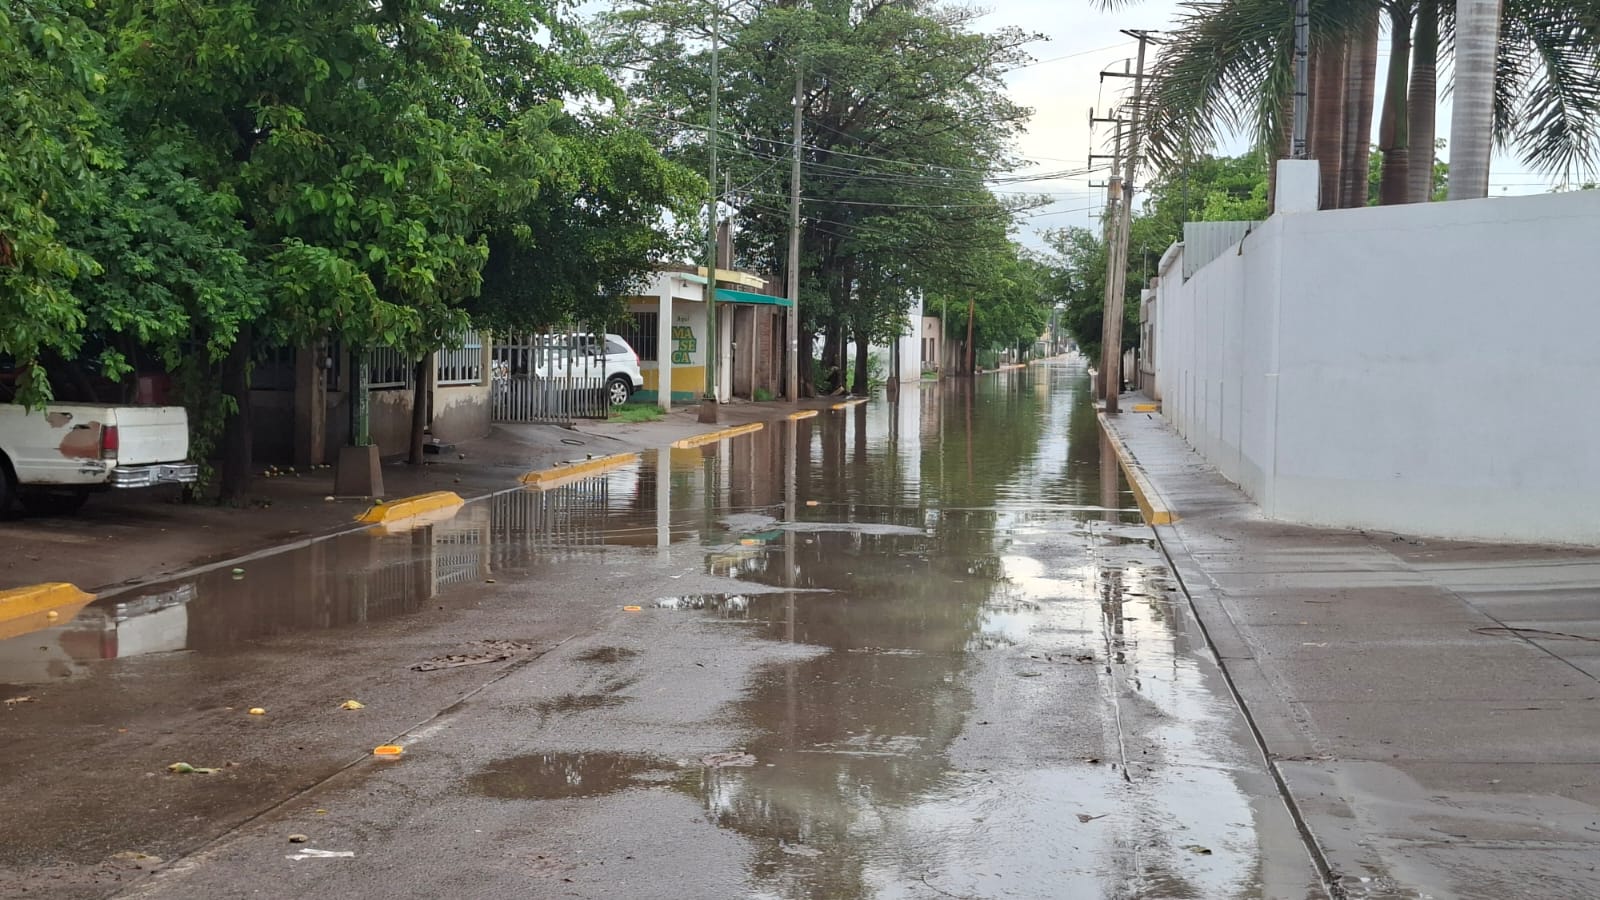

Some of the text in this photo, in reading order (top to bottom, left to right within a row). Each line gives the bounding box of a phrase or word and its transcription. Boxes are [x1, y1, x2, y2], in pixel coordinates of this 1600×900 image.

[672, 327, 693, 339] MA
[680, 340, 696, 352] SE
[672, 352, 690, 363] CA
